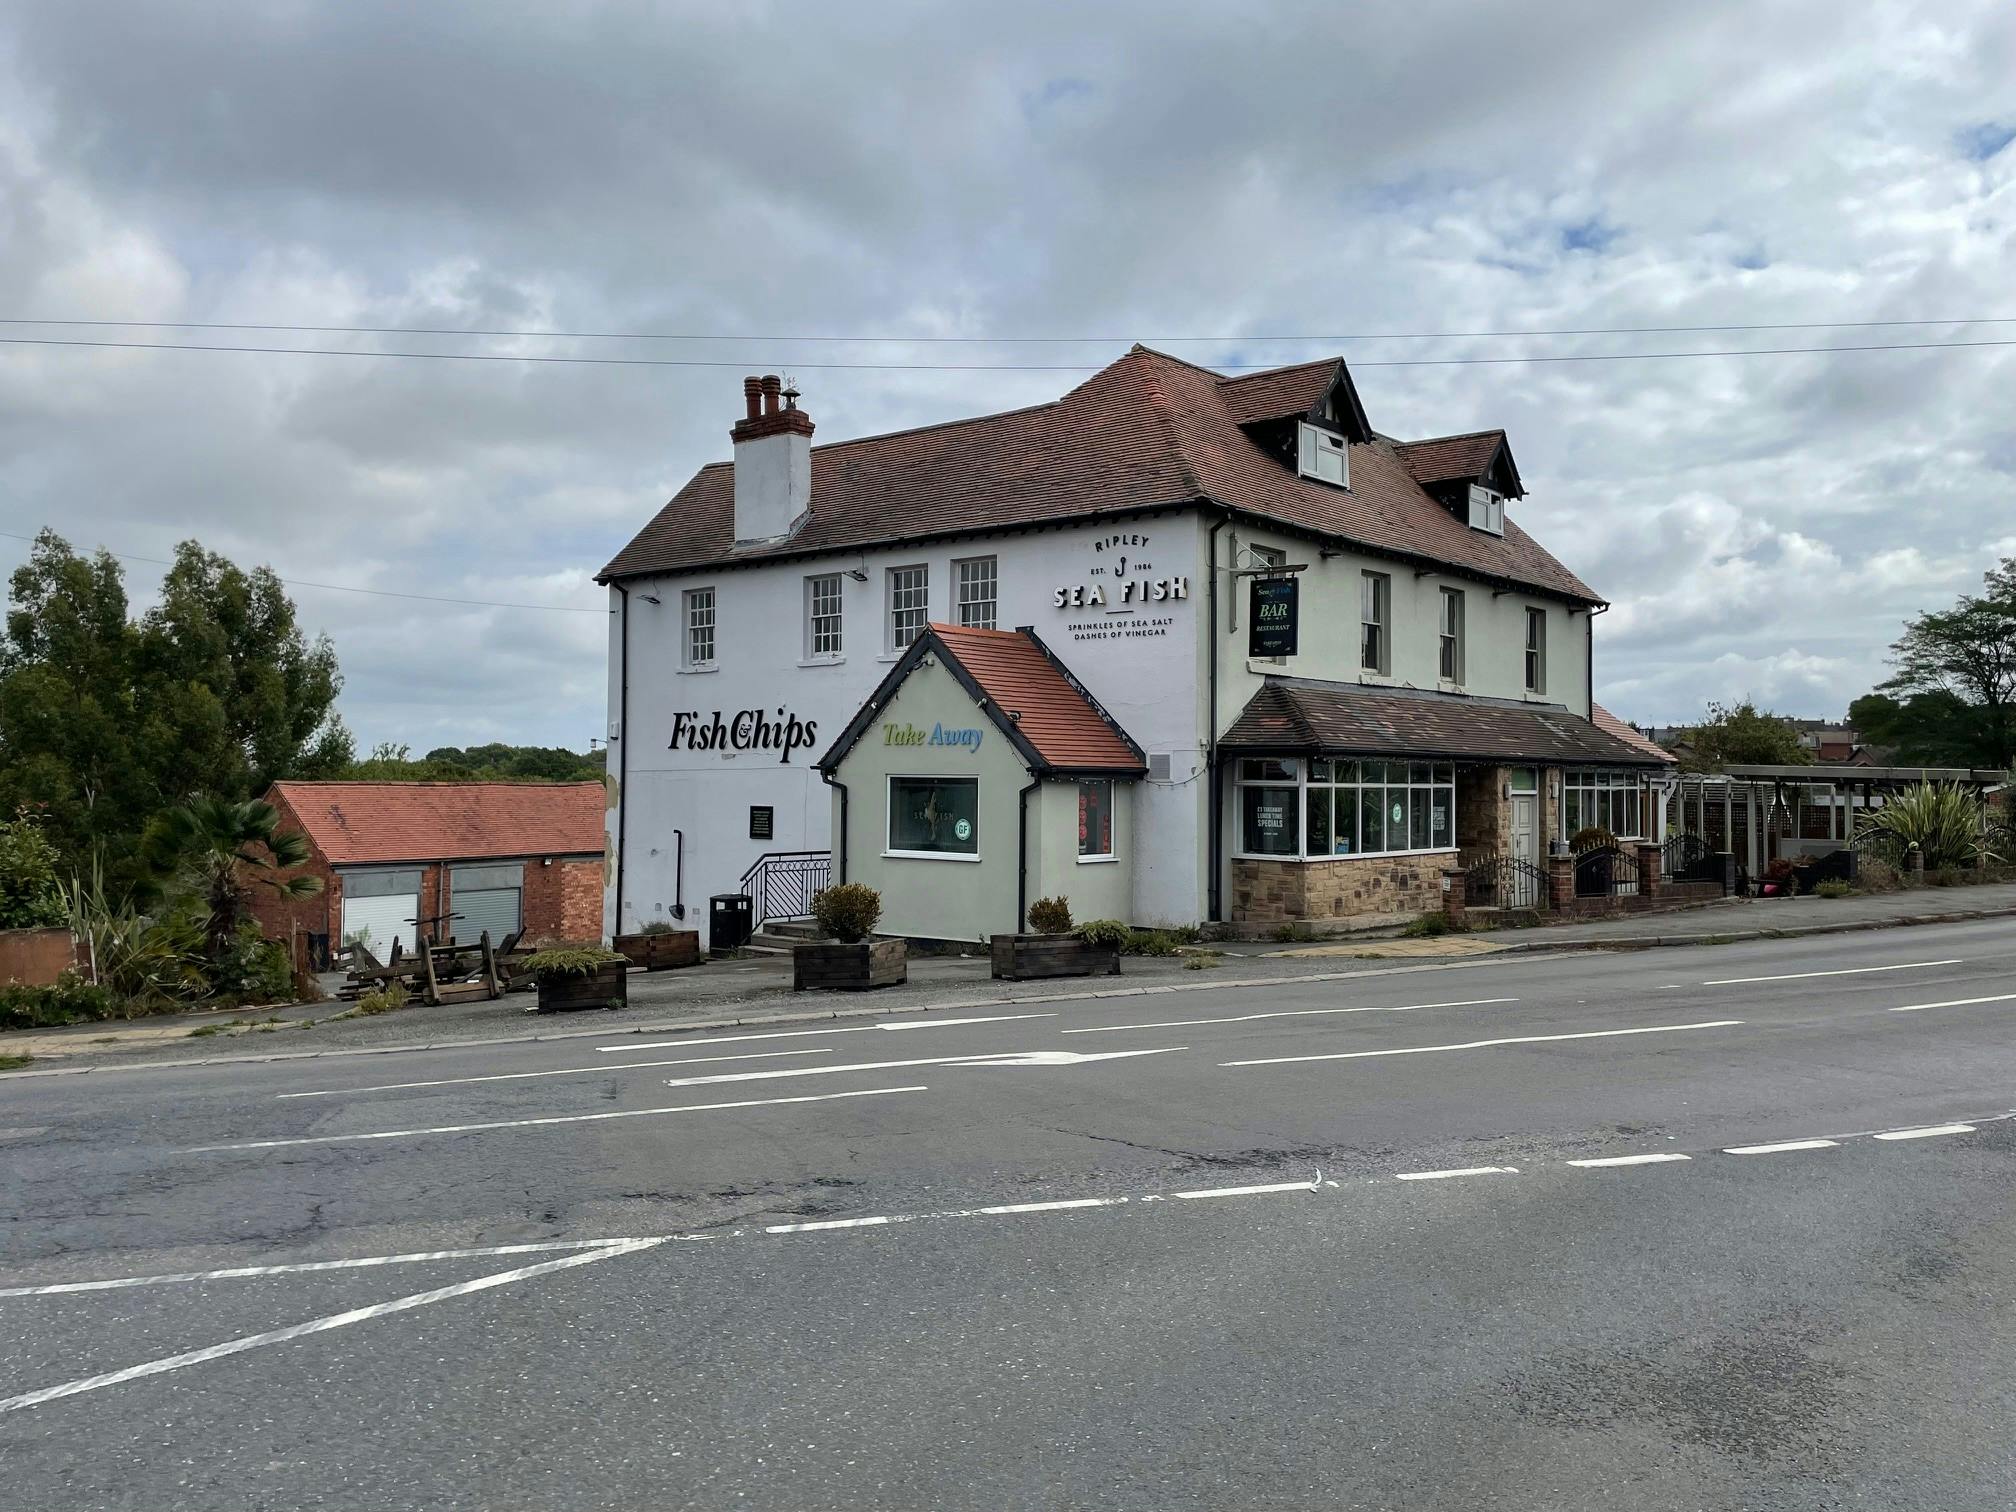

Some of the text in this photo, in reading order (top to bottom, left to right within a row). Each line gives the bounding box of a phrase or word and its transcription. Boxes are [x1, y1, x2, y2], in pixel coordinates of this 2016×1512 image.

[1095, 534, 1149, 552] RIPLEY
[1090, 567, 1106, 575] EST.
[1053, 577, 1188, 608] SEA FISH
[1260, 603, 1288, 617] BAR
[1068, 622, 1113, 631] SPRINKLES
[1152, 618, 1173, 626] SALT
[1256, 624, 1291, 632] RESTAURANT
[1074, 632, 1107, 640] DASHES
[1125, 629, 1166, 637] VINEGAR
[668, 711, 728, 750] Fish
[730, 707, 817, 764] Chips
[882, 721, 983, 754] Take Away
[958, 824, 968, 834] GF
[1257, 819, 1283, 827] SPECIALS
